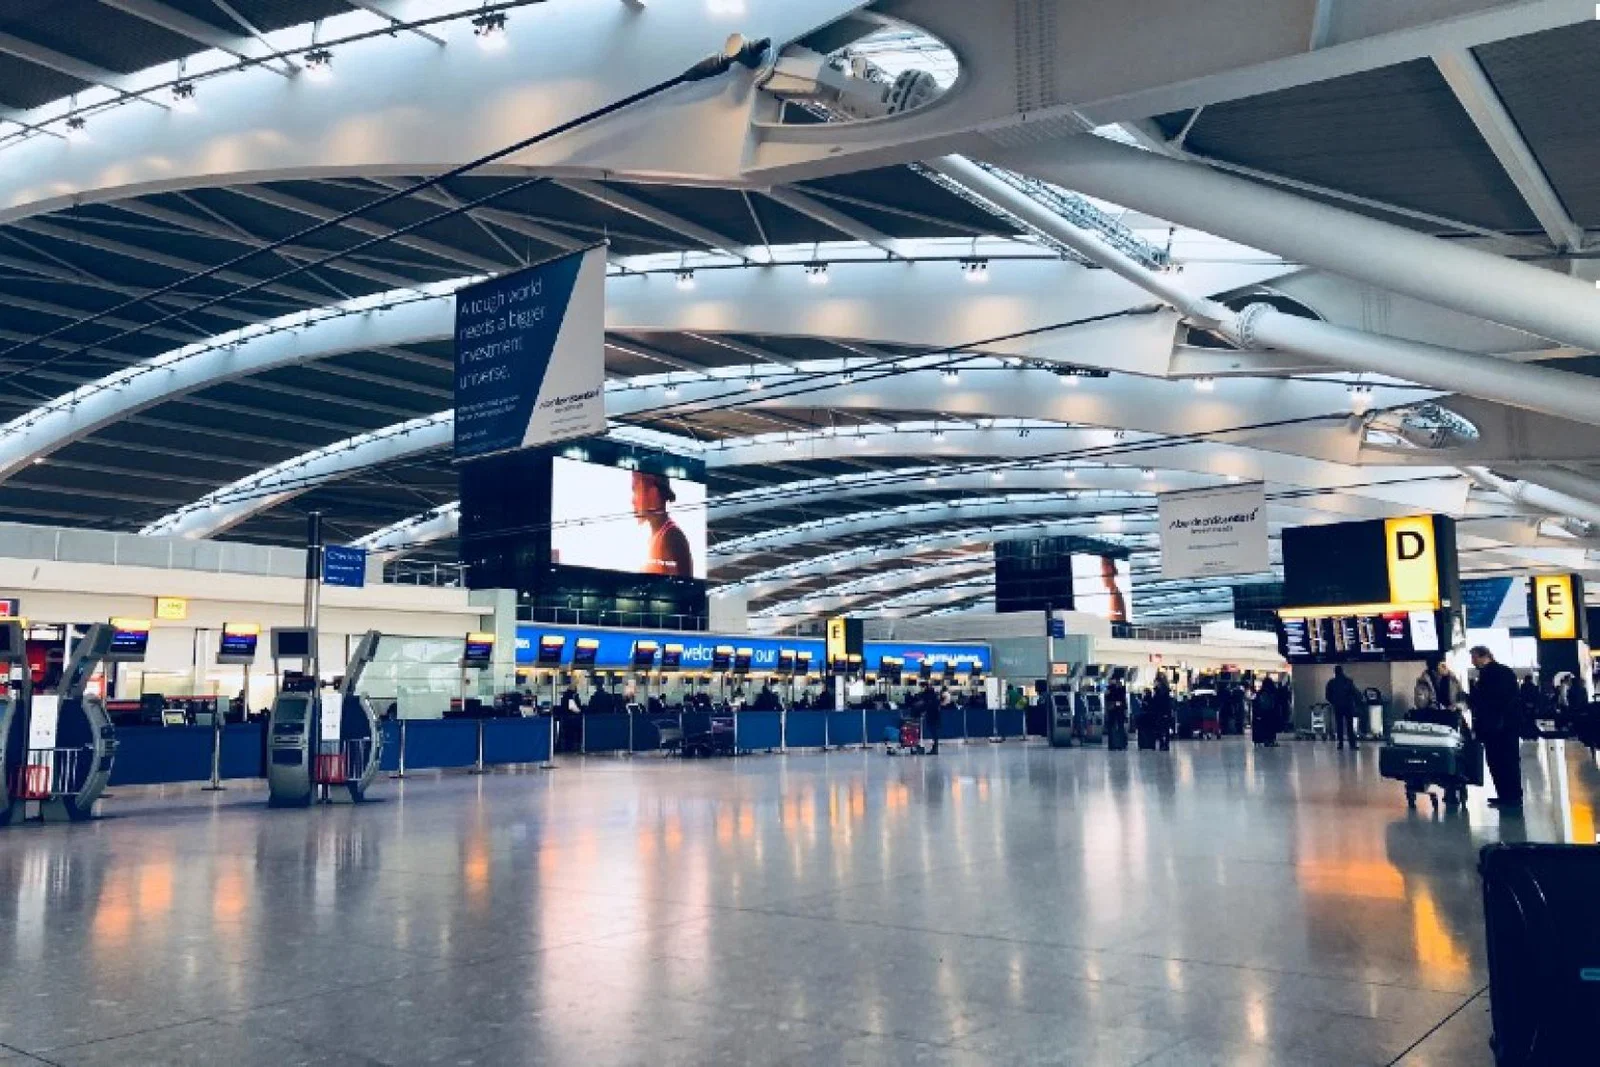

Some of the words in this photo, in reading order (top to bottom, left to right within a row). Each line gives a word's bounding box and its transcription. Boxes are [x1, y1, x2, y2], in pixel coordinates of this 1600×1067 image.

[471, 289, 505, 314] tough
[508, 277, 542, 303] world
[460, 319, 495, 340] needs
[498, 317, 506, 331] a
[509, 307, 545, 328] bigger
[1396, 531, 1425, 561] D
[1546, 584, 1562, 605] E
[832, 624, 841, 638] E
[683, 643, 736, 663] welcoe
